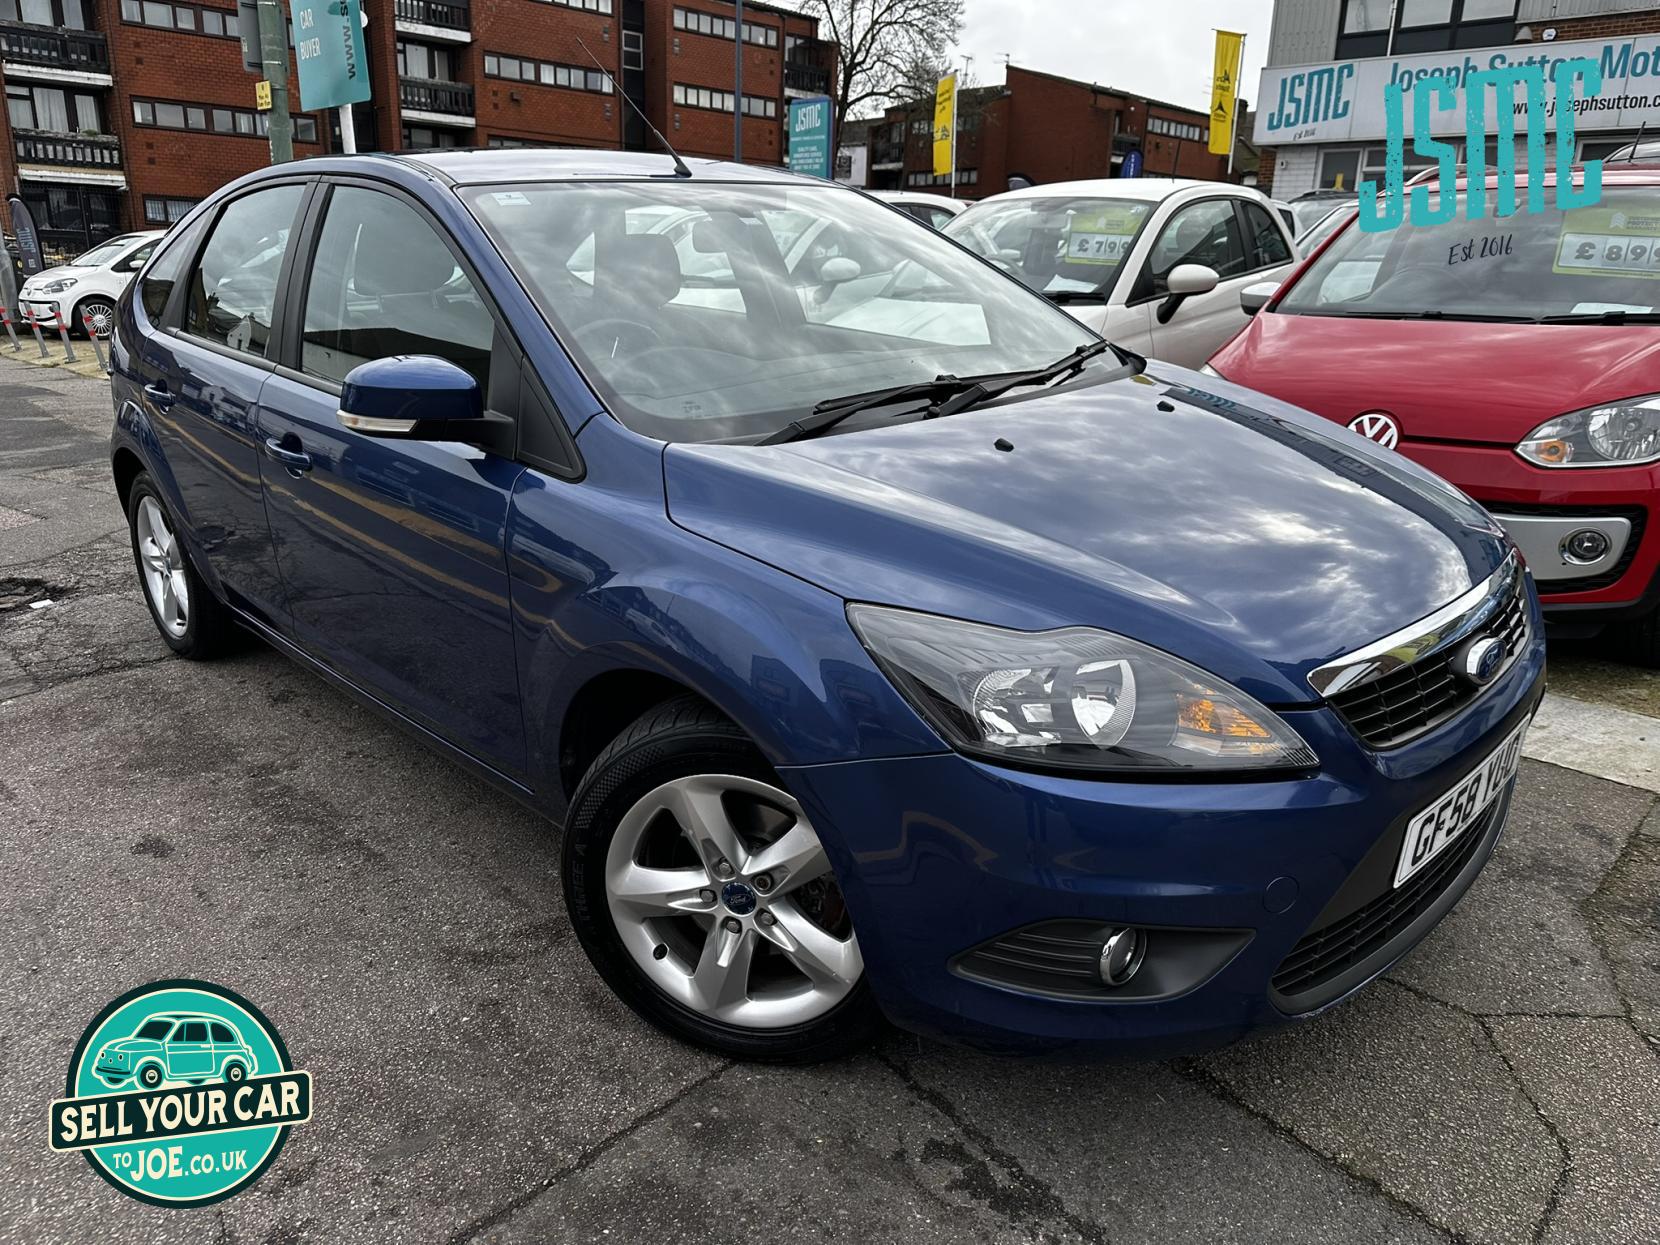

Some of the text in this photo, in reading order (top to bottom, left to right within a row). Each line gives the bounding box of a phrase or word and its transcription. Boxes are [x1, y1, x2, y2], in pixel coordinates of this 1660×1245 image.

[300, 8, 314, 29] CAR
[300, 37, 321, 60] BUYER
[1600, 43, 1660, 79] Mot
[1267, 63, 1354, 131] JSMC
[796, 104, 821, 132] JSMC
[1411, 773, 1482, 867] GF58
